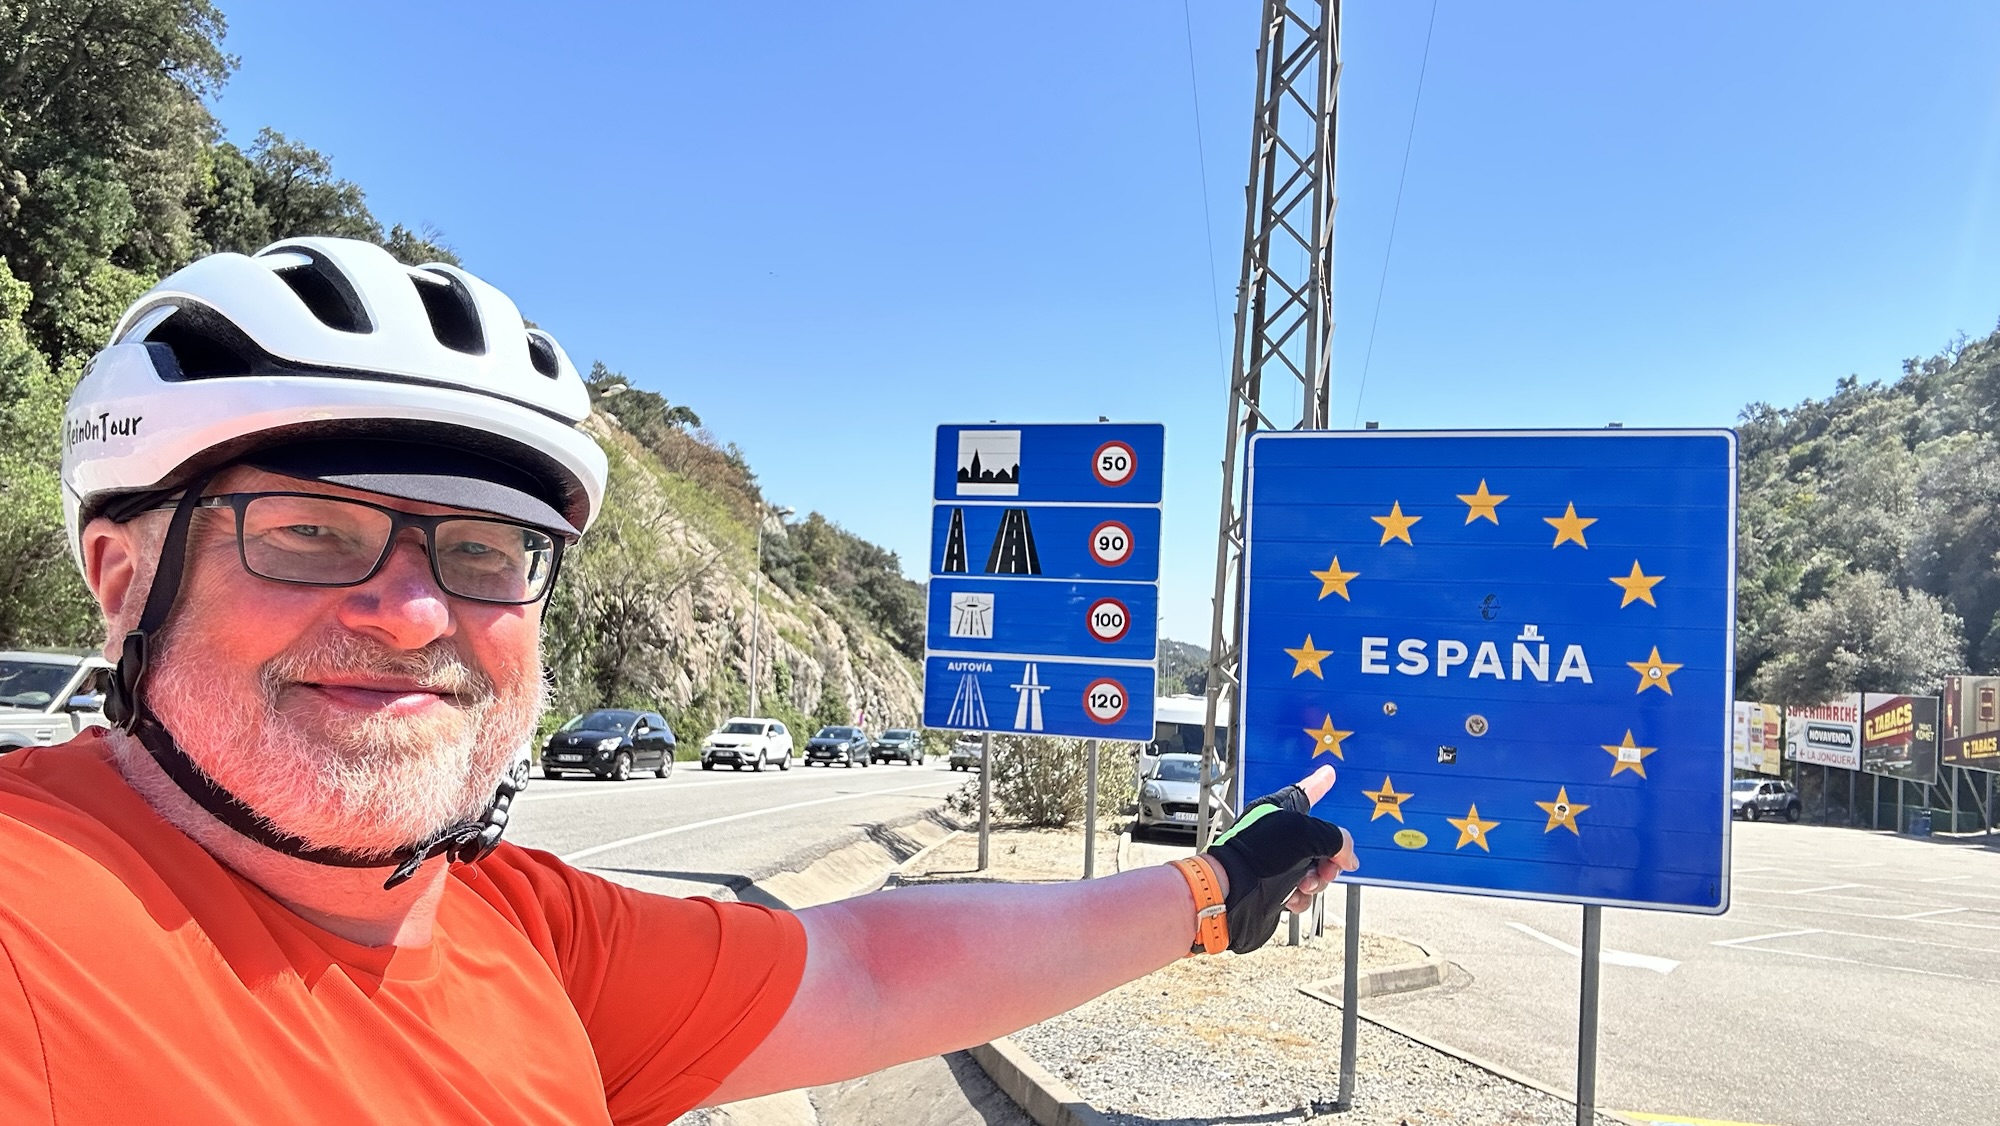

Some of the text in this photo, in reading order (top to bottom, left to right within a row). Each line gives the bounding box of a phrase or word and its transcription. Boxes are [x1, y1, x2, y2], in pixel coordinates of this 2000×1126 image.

[66, 412, 143, 453] ReinOnTour
[1102, 456, 1127, 471] 50
[1099, 536, 1125, 551] 90
[1094, 612, 1123, 628] 100
[1361, 634, 1594, 684] ESPAÑA
[947, 661, 993, 673] AUTOVÍA
[1090, 693, 1122, 708] 120
[1874, 703, 1913, 733] TABACS
[1808, 729, 1851, 744] NOVAVENDA
[1971, 737, 1998, 754] TABACS
[1807, 751, 1857, 766] LA JONQUERA
